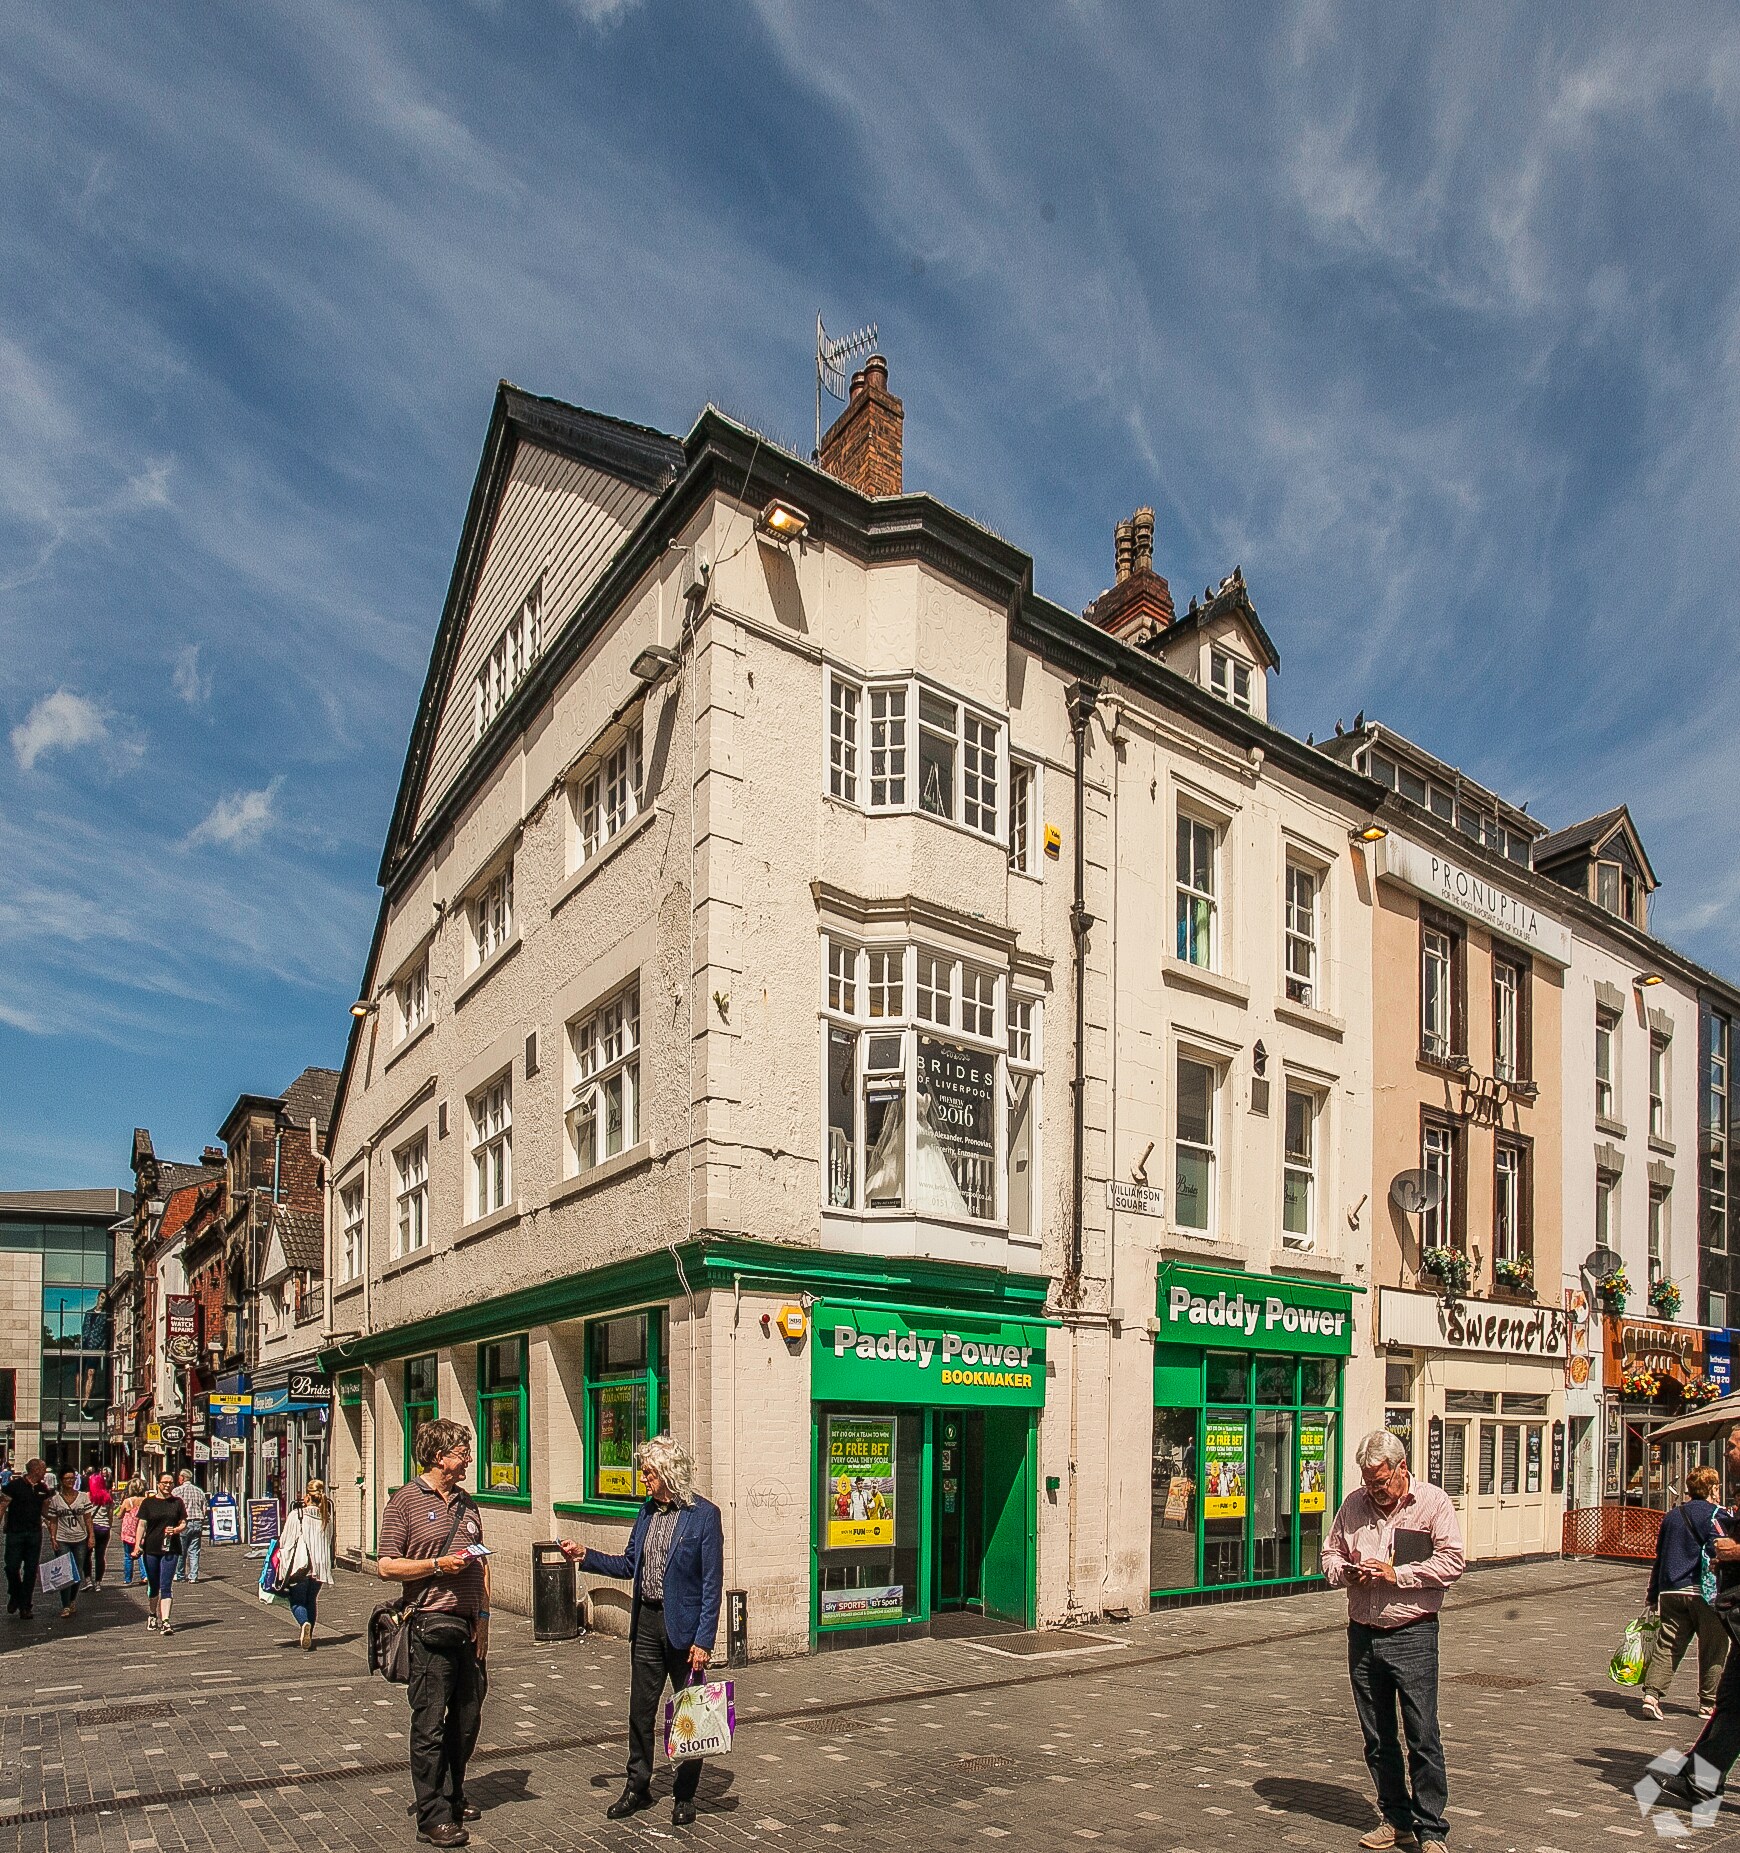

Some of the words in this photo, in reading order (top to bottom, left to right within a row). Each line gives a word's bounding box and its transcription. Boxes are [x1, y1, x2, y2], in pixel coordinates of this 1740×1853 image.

[1431, 857, 1538, 935] PRONUPTIA
[1442, 888, 1451, 900] FOR
[1452, 893, 1460, 905] THE
[1461, 898, 1473, 911] MOST
[1474, 904, 1496, 924] IMPORTANT
[1497, 917, 1505, 928] DAY
[1505, 922, 1511, 931] OF
[1512, 925, 1523, 939] YOUR
[917, 1055, 993, 1086] BRIDES
[917, 1075, 930, 1085] OF
[935, 1079, 991, 1100] LIVERPOOL
[938, 1104, 974, 1127] 2016
[934, 1130, 964, 1144] Alexander,
[964, 1136, 993, 1150] Pronovias,
[1110, 1183, 1160, 1202] WILLIAMSON
[1115, 1196, 1148, 1212] SQUARE
[1169, 1285, 1260, 1336] Paddy
[1265, 1296, 1346, 1336] Power
[834, 1324, 936, 1369] Paddy
[942, 1333, 1033, 1368] Power
[290, 1375, 331, 1395] Brides
[941, 1369, 1033, 1388] BOOKMAKER
[831, 1442, 843, 1456] £2
[845, 1442, 869, 1456] FREE
[871, 1443, 890, 1456] BET
[1206, 1434, 1216, 1446] £2
[1216, 1434, 1231, 1446] FREE
[1231, 1434, 1244, 1446] BET
[1313, 1434, 1324, 1445] BET
[831, 1456, 846, 1464] EVERY
[846, 1456, 860, 1464] GOAL
[860, 1456, 873, 1464] THEY
[873, 1456, 889, 1464] SCORE
[67, 1516, 78, 1528] 10
[853, 1528, 866, 1536] FUN
[825, 1603, 837, 1612] sky
[838, 1601, 866, 1611] SPORTS
[871, 1598, 881, 1607] BT
[881, 1598, 898, 1607] Sport
[679, 1736, 720, 1754] storm
